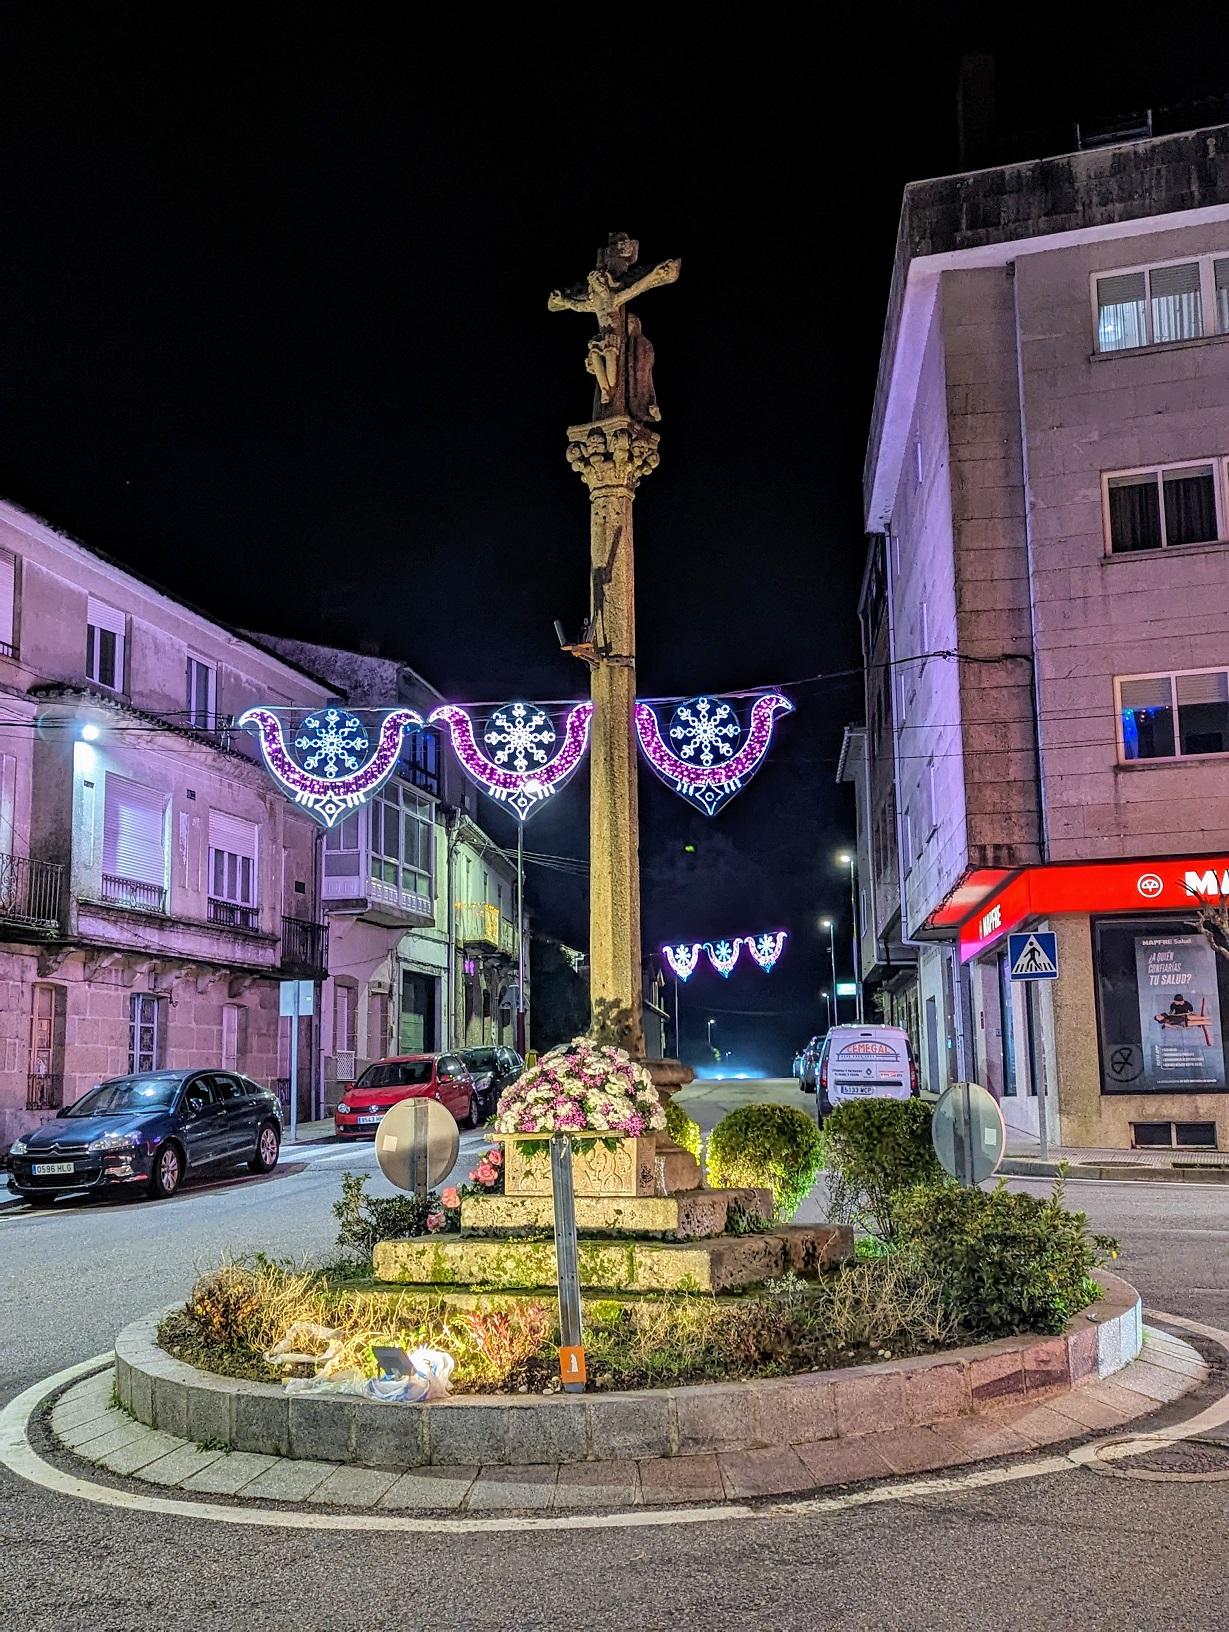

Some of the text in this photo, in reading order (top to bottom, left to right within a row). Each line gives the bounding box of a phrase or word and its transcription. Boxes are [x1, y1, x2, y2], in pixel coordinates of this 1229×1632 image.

[1150, 974, 1192, 986] TU SALUD?
[37, 1164, 72, 1174] 0596 HLG
